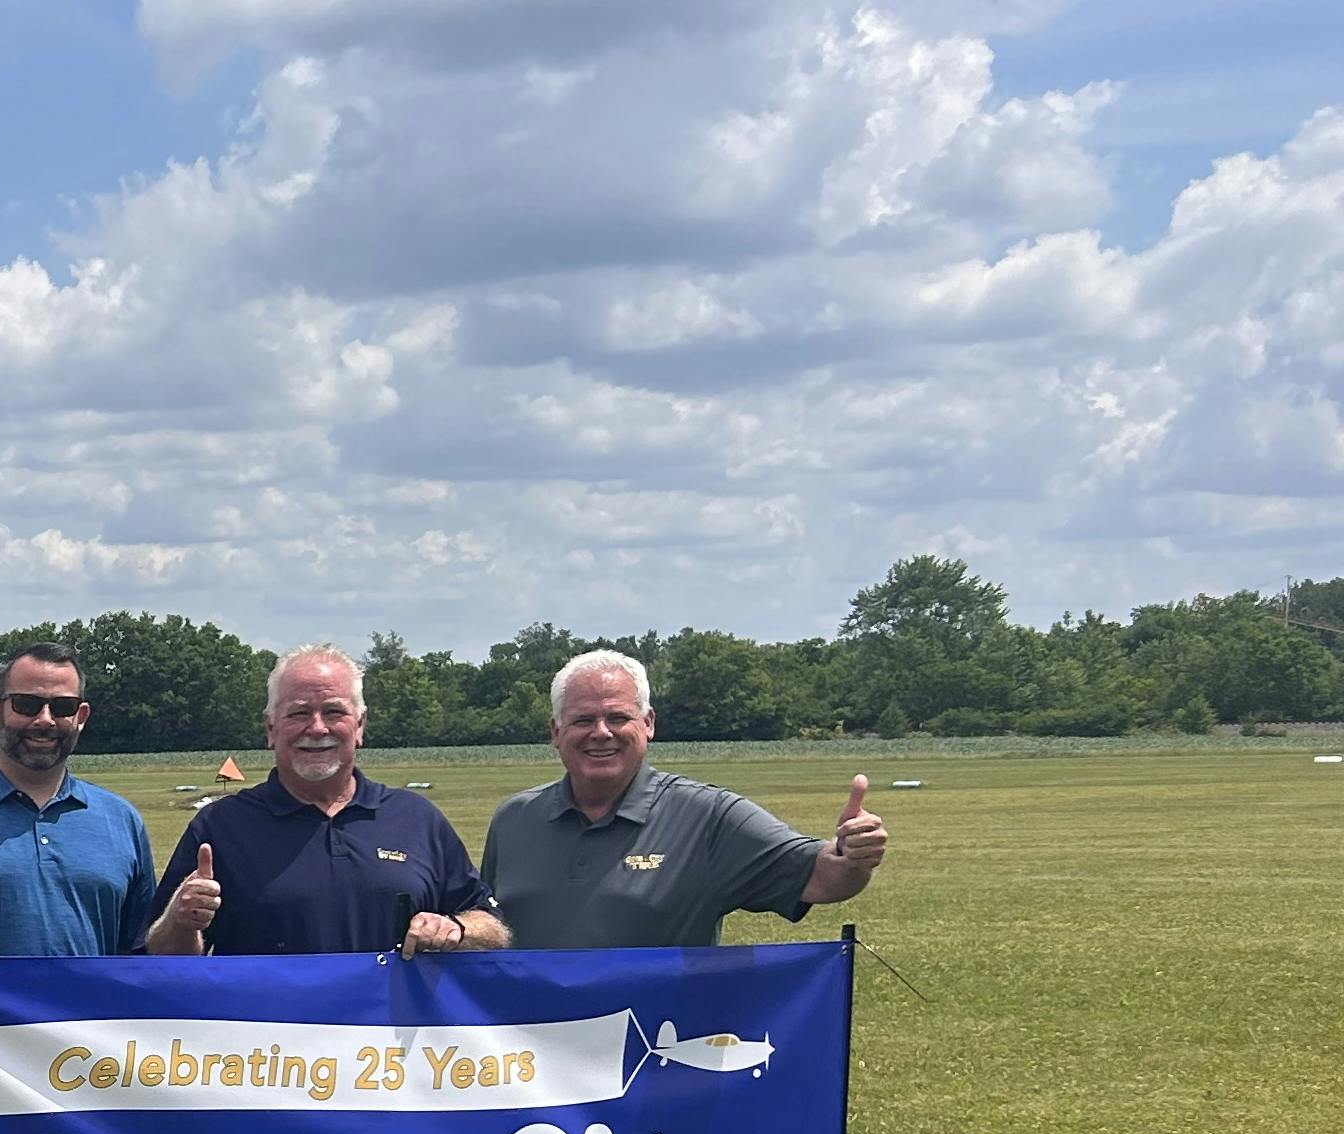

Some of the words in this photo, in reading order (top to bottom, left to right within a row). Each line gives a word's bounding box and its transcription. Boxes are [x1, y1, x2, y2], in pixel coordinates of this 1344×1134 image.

[48, 1038, 338, 1101] Celebrating
[353, 1045, 407, 1091] 25
[422, 1045, 536, 1091] Years
